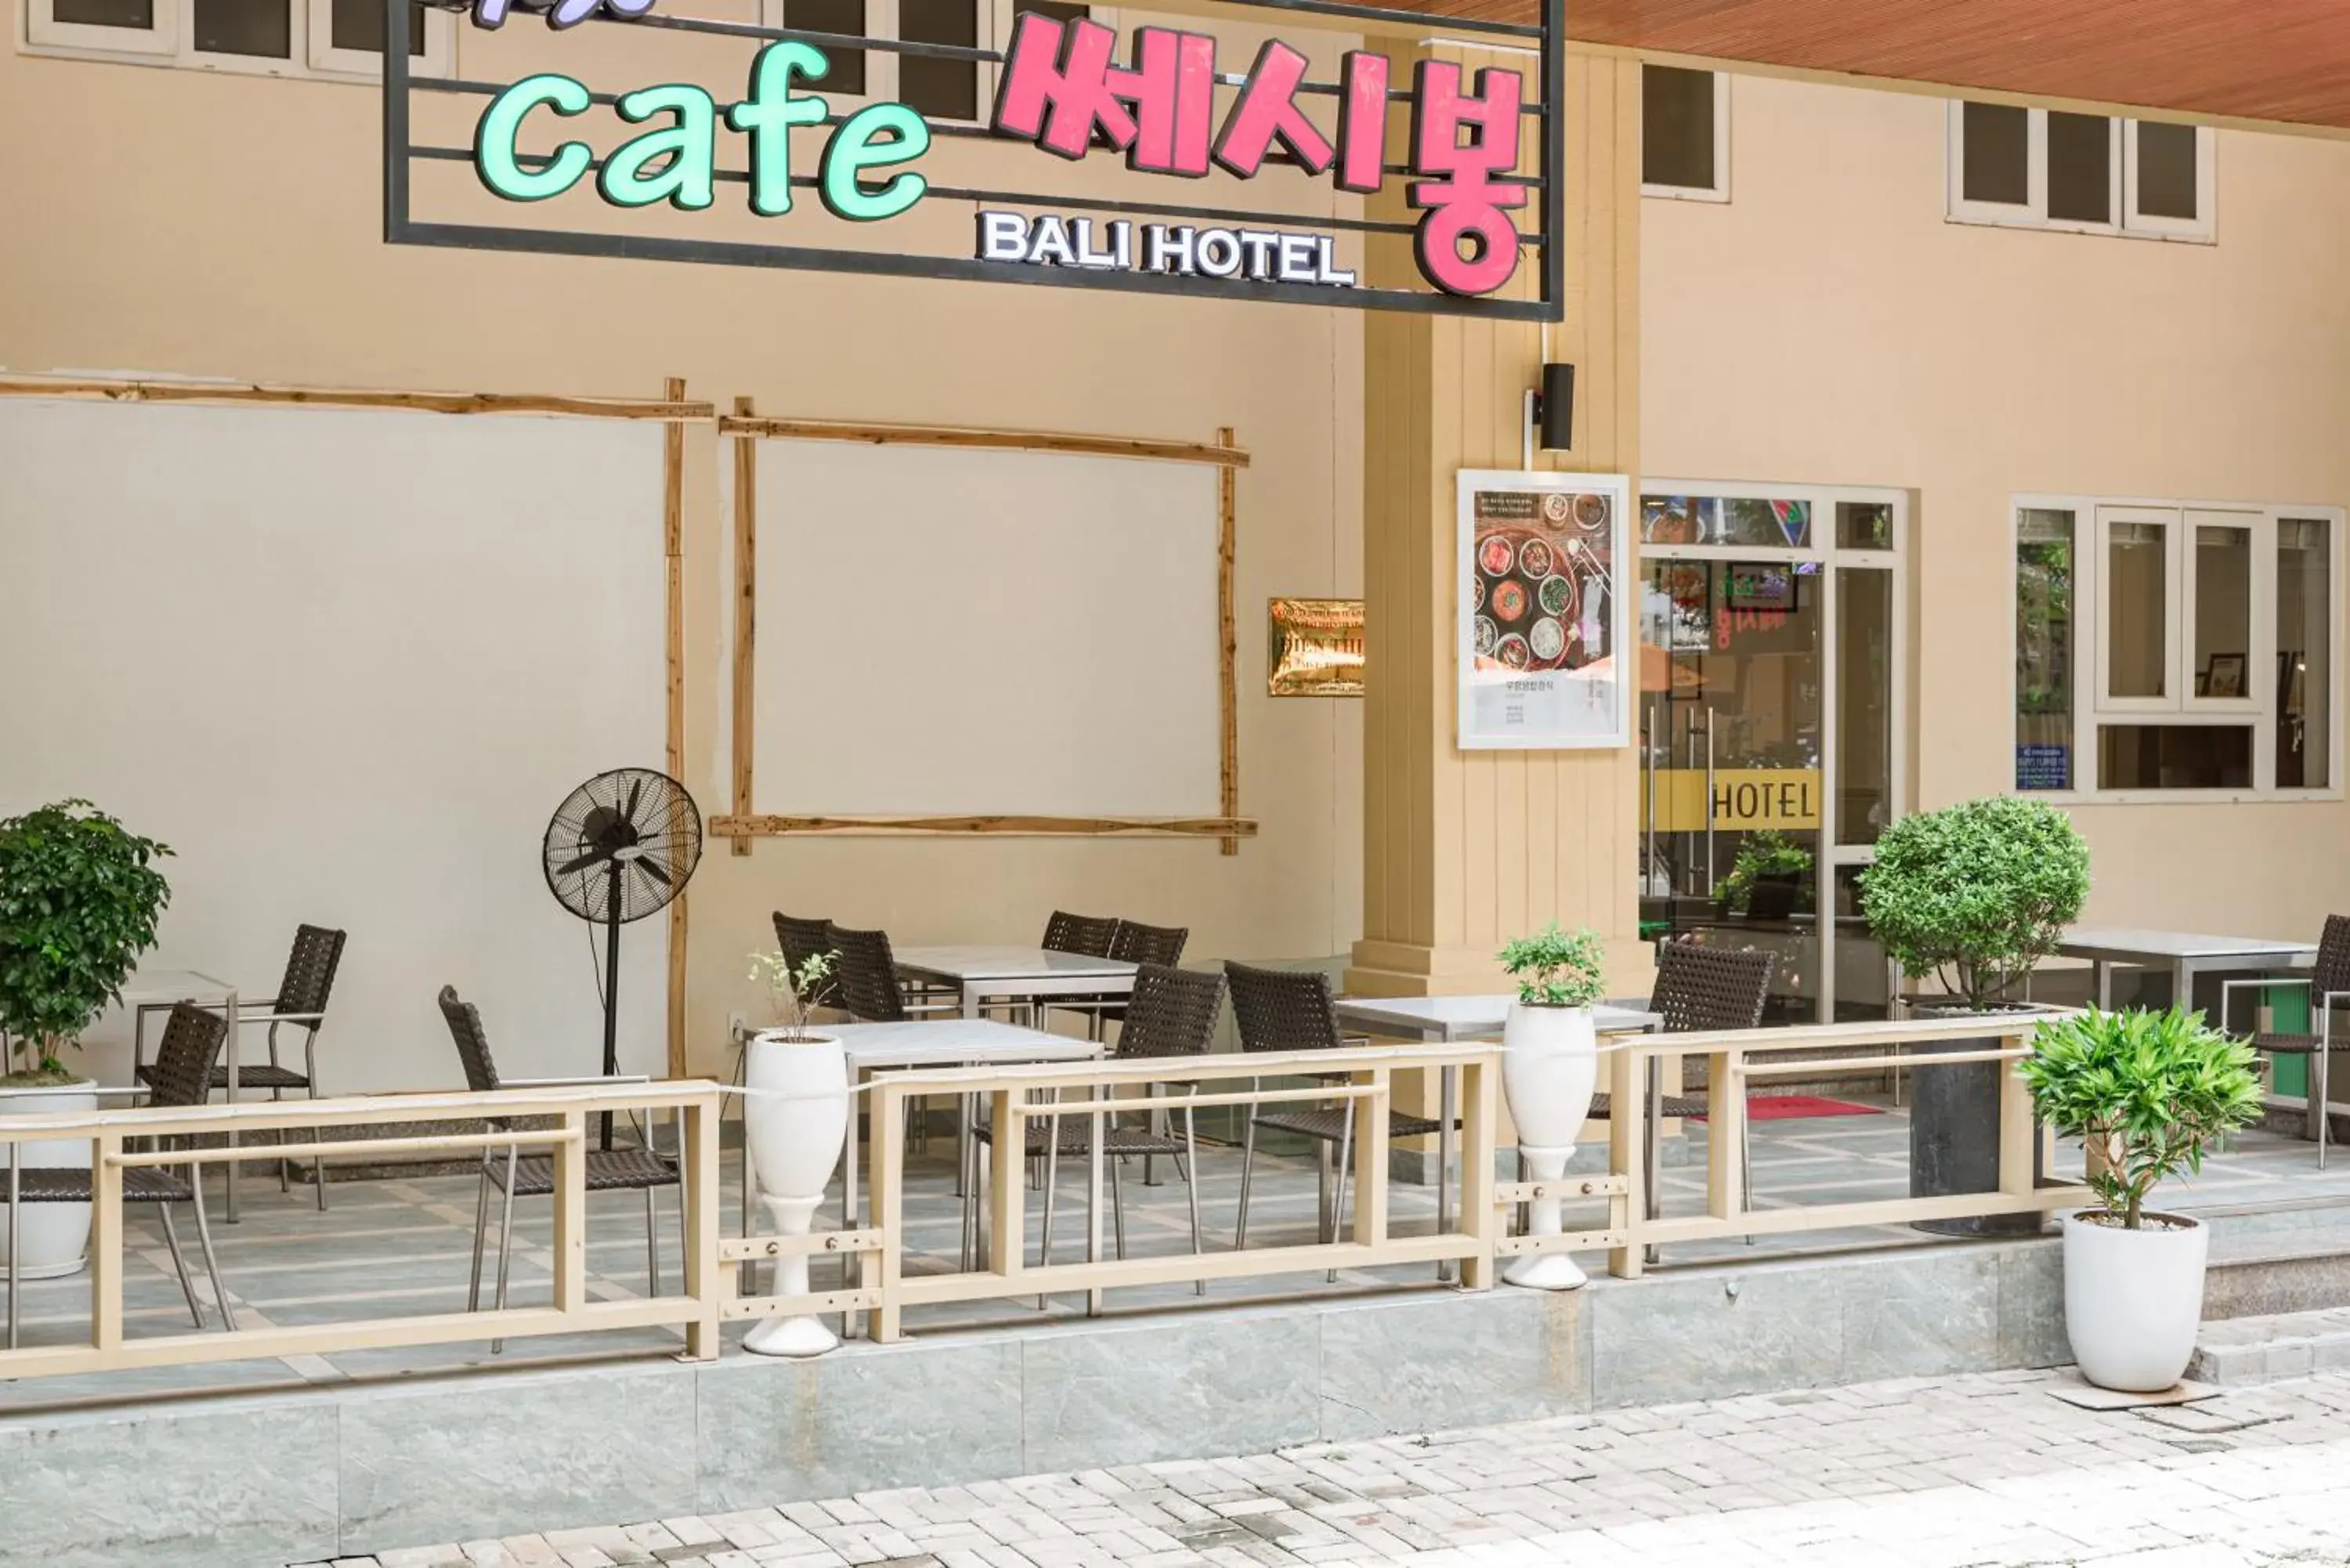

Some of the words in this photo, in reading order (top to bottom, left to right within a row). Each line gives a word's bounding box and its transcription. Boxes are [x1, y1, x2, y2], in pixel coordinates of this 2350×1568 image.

[475, 39, 931, 221] cafe
[992, 12, 1528, 296] 쎄시봉
[976, 211, 1132, 271] BALI
[1141, 224, 1356, 287] HOTEL
[1713, 782, 1816, 819] HOTEL
